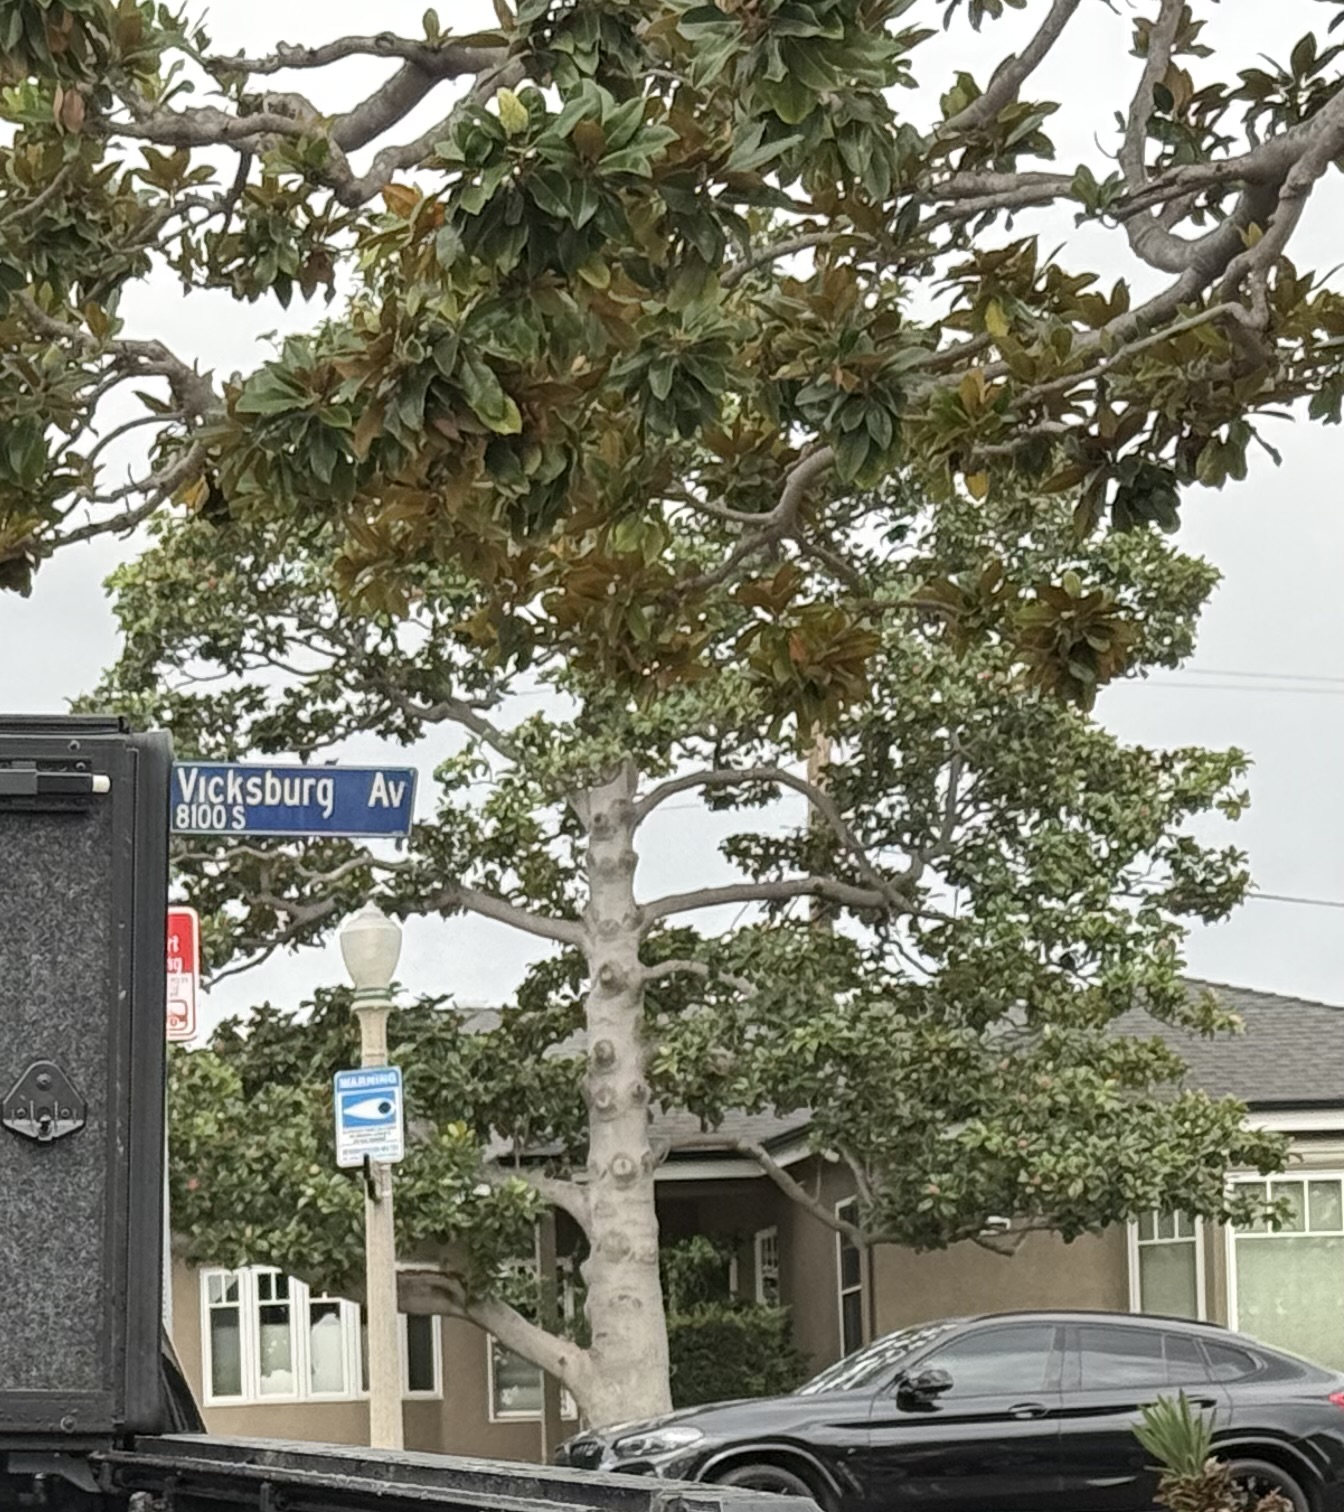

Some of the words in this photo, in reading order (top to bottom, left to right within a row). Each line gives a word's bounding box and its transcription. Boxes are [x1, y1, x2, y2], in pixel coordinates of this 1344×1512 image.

[177, 767, 334, 819] Vicksburg
[367, 771, 406, 808] Av
[176, 804, 227, 829] 8100
[231, 804, 246, 829] S
[339, 1072, 397, 1089] WARNING
